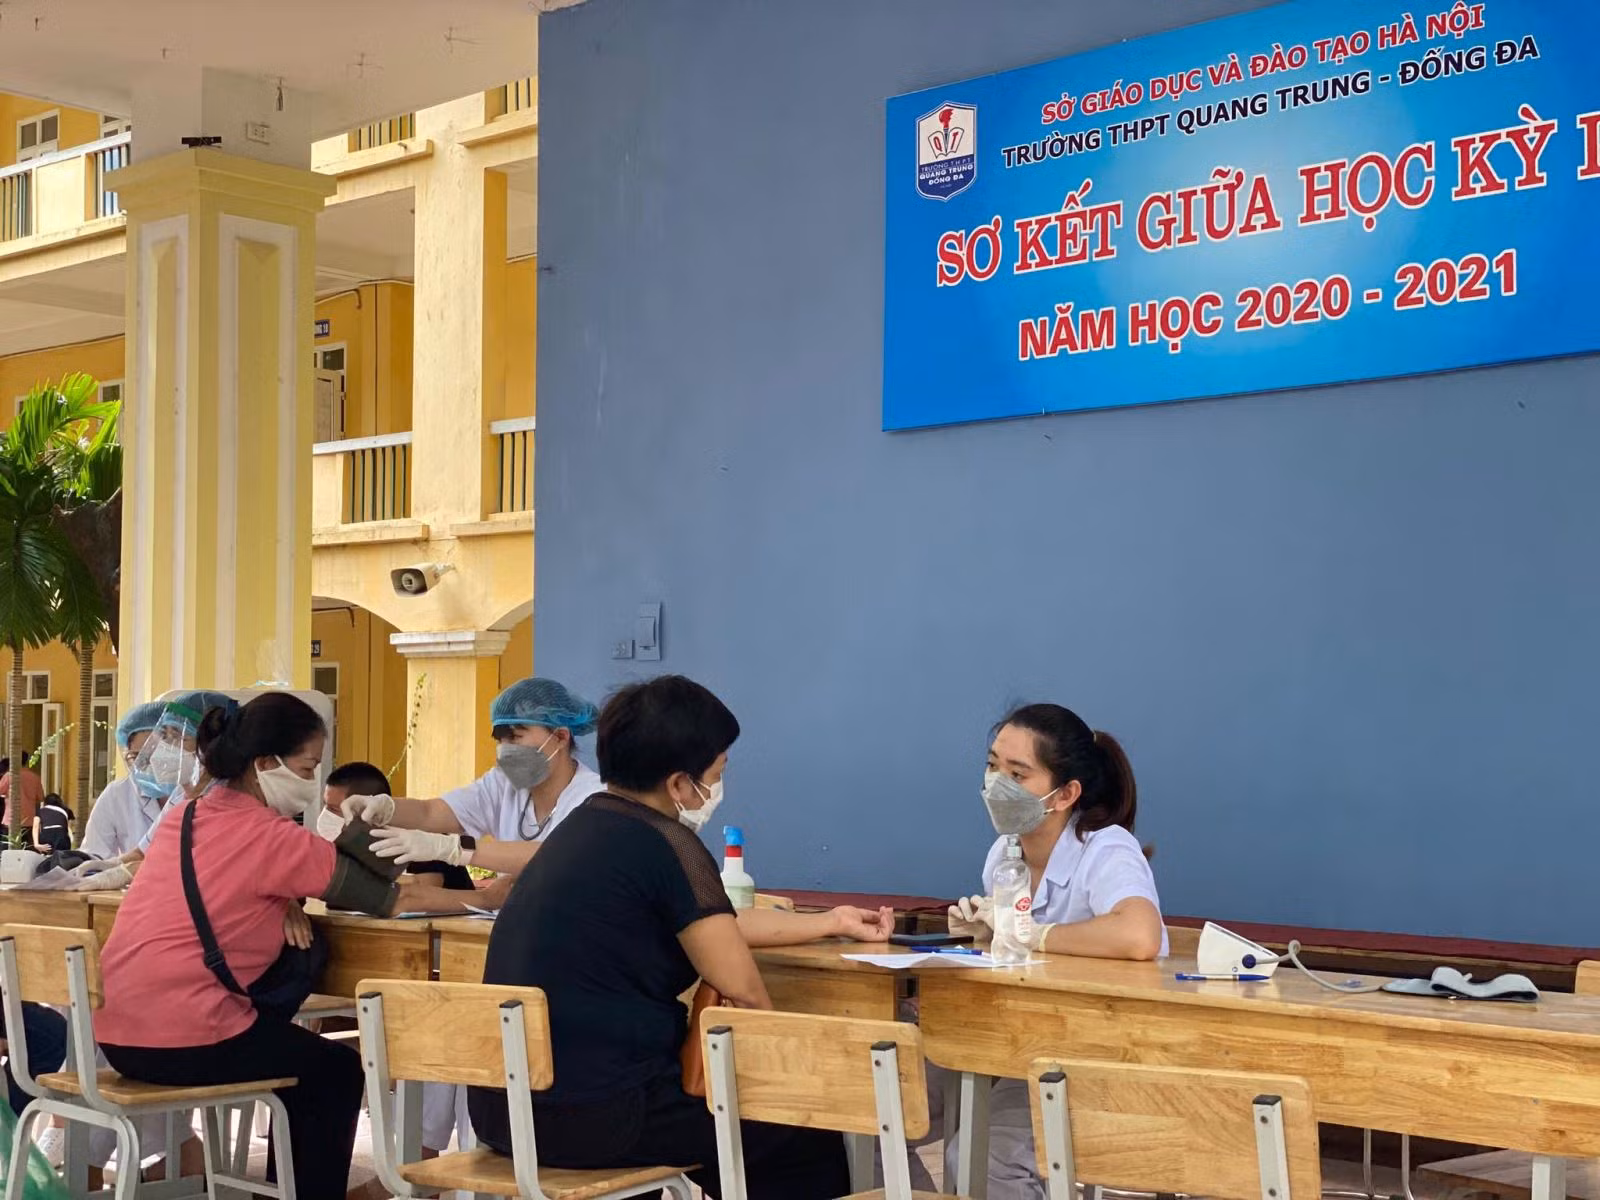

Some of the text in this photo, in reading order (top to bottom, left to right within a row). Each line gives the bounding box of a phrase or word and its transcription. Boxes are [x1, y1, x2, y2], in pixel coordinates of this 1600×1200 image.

[1002, 35, 1540, 168] TRƯỜNG THPT QUANG TRUNG - ĐỐNG ĐA
[1041, 1, 1485, 124] SỞ GIÁO DỤC VÀ ĐÀO TẠO HÀ NỘI
[920, 164, 973, 180] QUANG TRUNG
[937, 215, 1003, 287] SƠ
[1013, 178, 1123, 274] KẾT
[1137, 166, 1282, 252] GIỮA
[1298, 141, 1436, 232] HỌC
[1452, 103, 1558, 201] KỲ
[1018, 248, 1517, 361] NĂM HỌC 2020 - 2021
